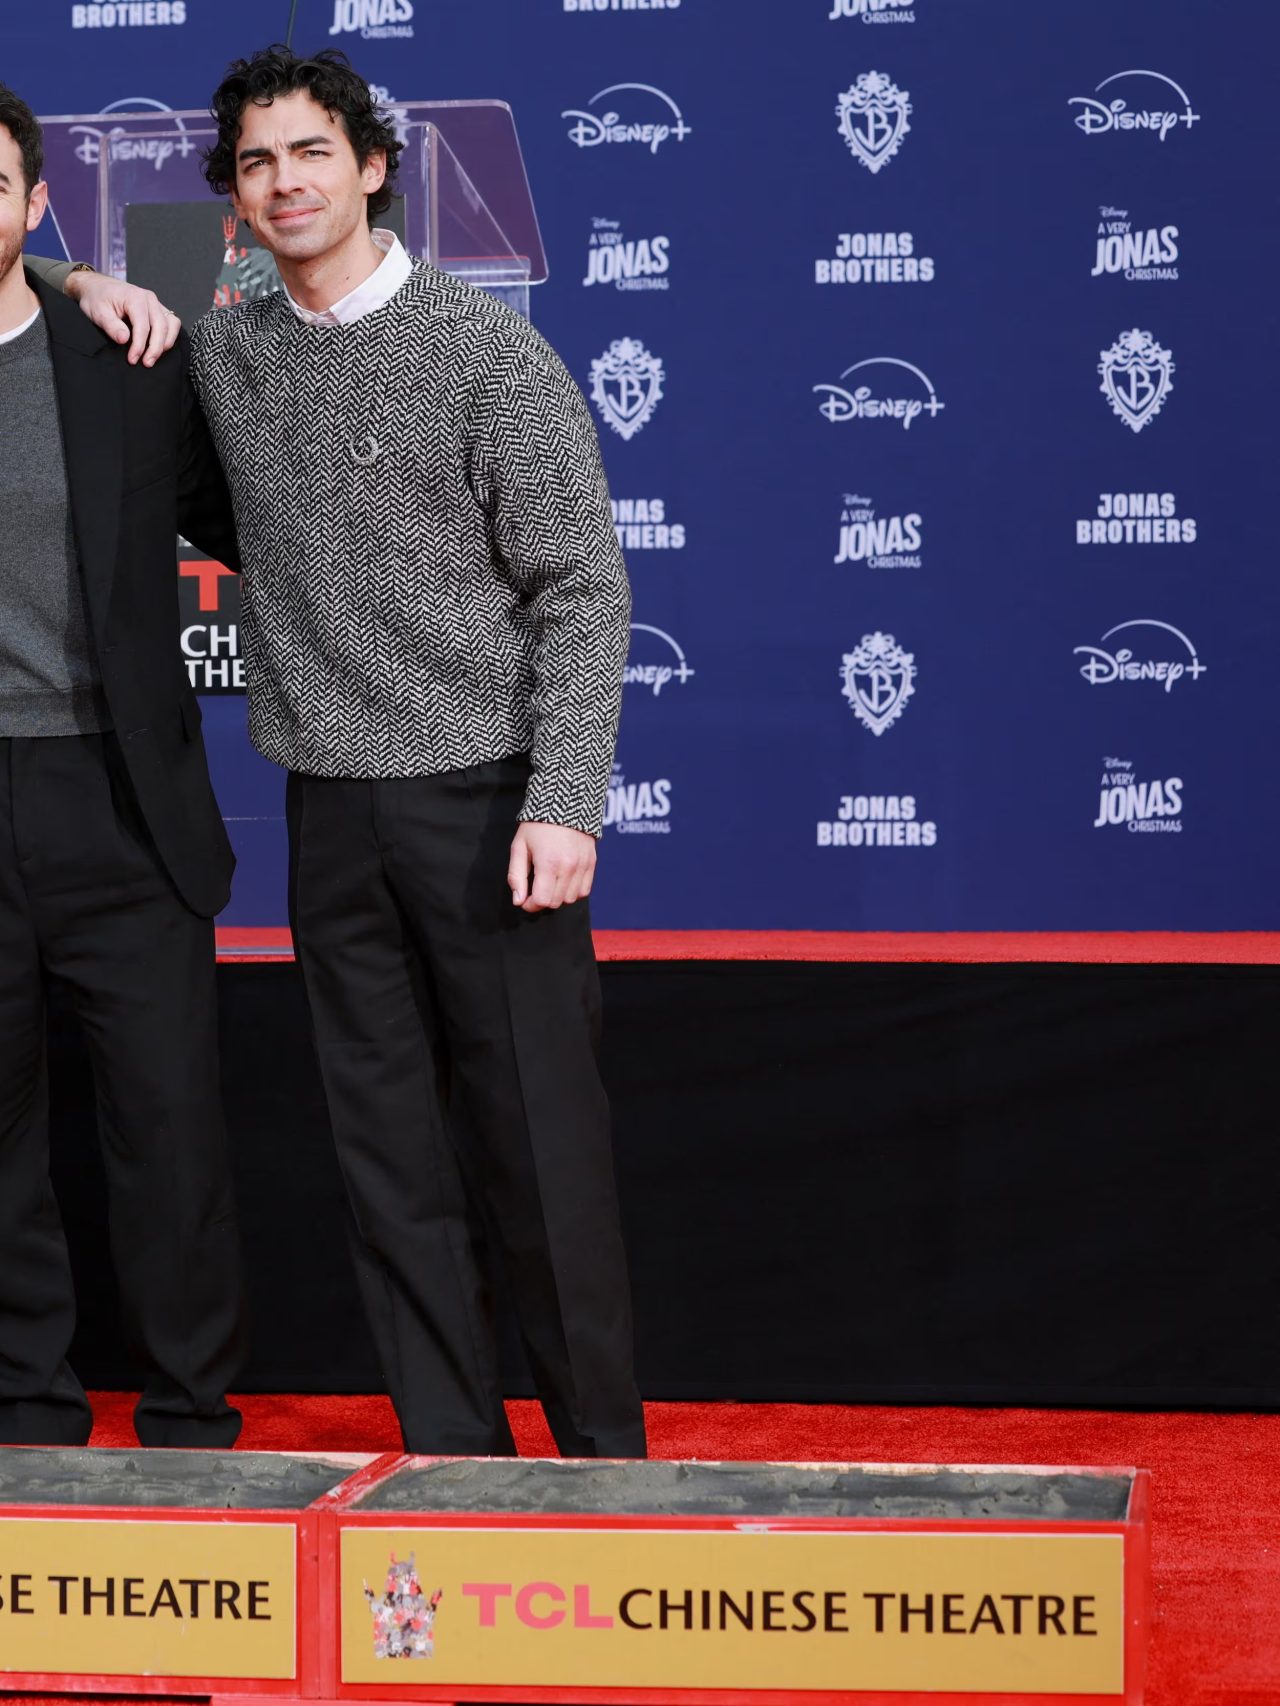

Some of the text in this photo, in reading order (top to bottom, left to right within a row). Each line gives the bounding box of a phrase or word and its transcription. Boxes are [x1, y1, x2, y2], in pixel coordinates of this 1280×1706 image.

[72, 1, 186, 28] BROTHERS
[562, 110, 691, 153] Disney+
[1068, 97, 1200, 141] Disney+
[836, 232, 913, 257] JONAS
[1106, 221, 1131, 234] VERY
[582, 235, 670, 286] JONAS
[815, 257, 934, 283] BROTHERS
[1091, 225, 1179, 276] JONAS
[1124, 267, 1179, 280] CHRISTMAS
[813, 384, 945, 429] Disney+
[1098, 493, 1175, 517] JONAS
[615, 524, 685, 549] THERS
[834, 512, 922, 563] JONAS
[1077, 518, 1196, 544] BROTHERS
[1074, 646, 1206, 692] Disney+
[602, 778, 672, 826] ONAS
[838, 796, 915, 821] JONAS
[1094, 777, 1183, 828] JONAS
[817, 821, 936, 846] BROTHERS
[48, 1576, 272, 1620] THEATRE
[463, 1582, 1098, 1636] TCL CHINESE THEATRE
